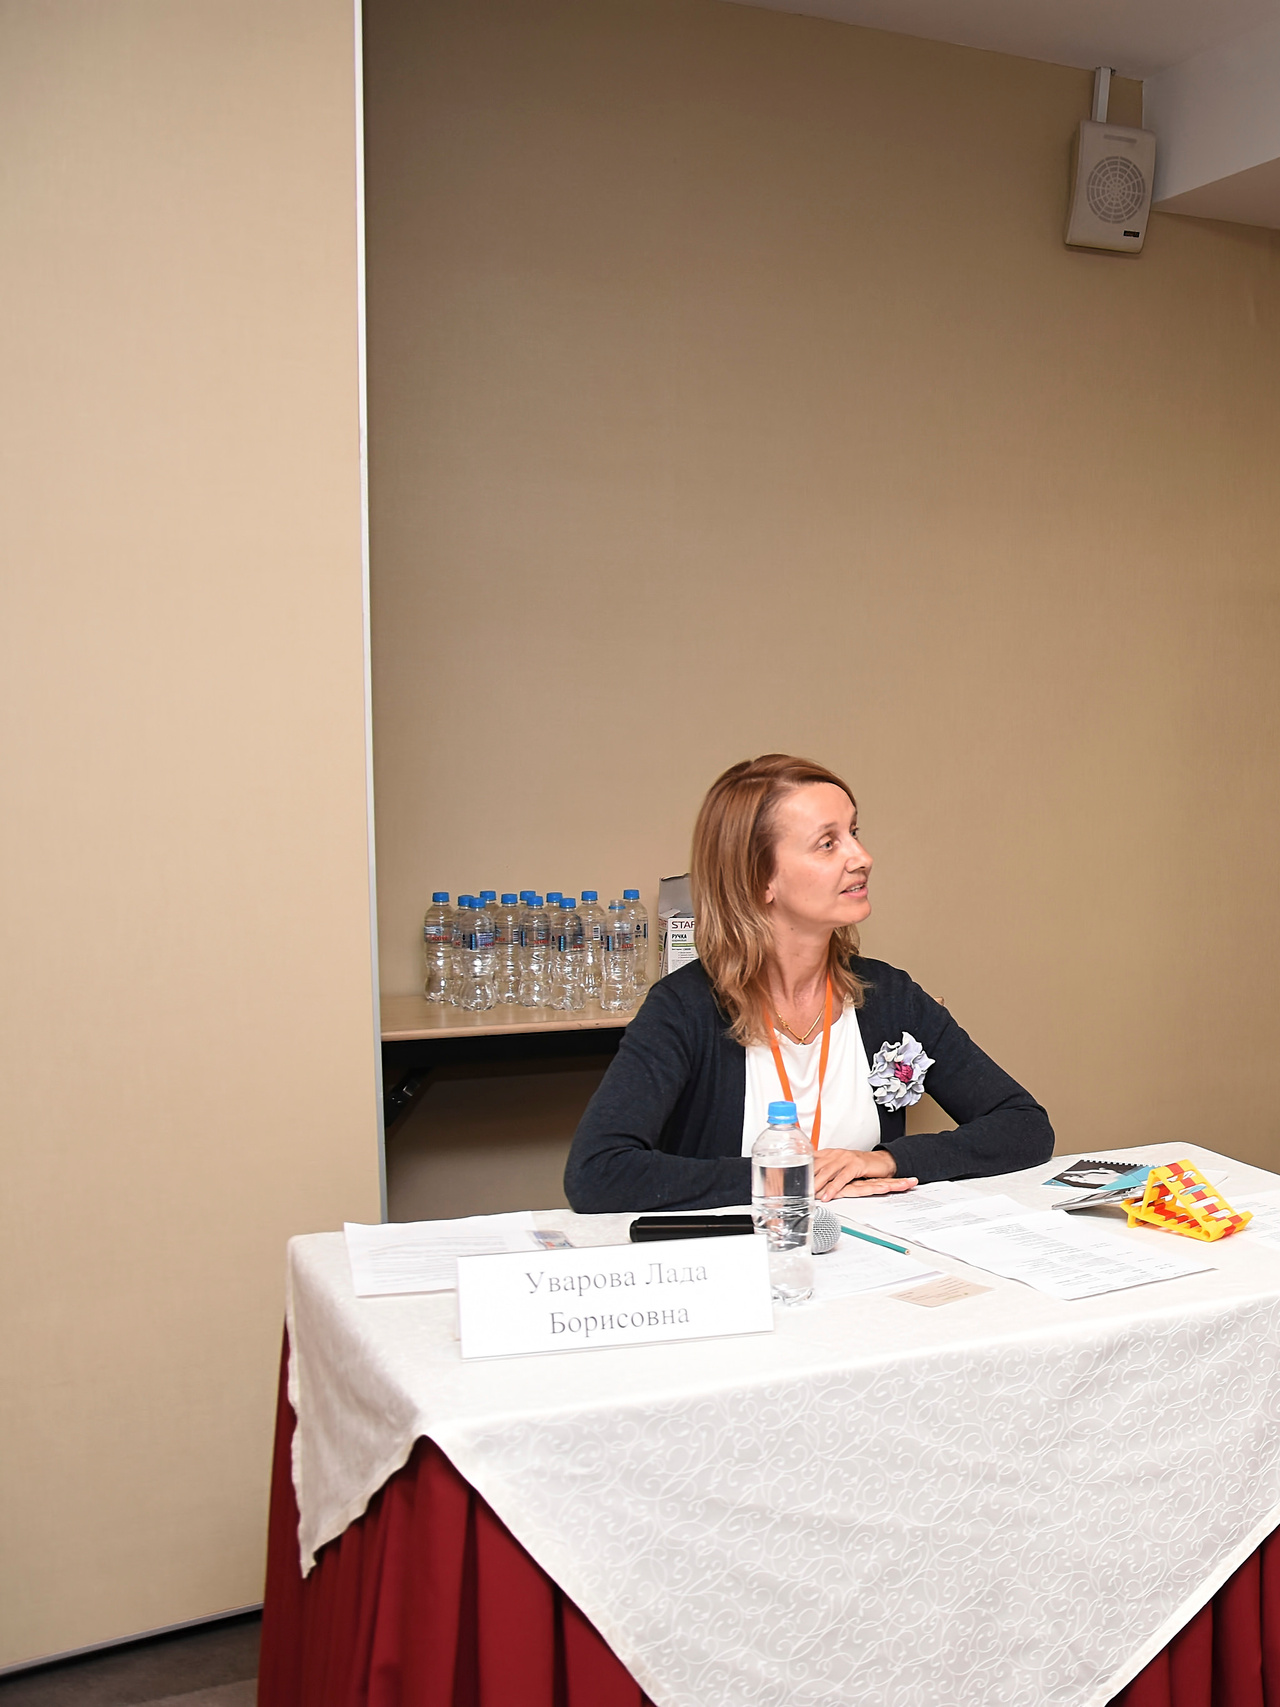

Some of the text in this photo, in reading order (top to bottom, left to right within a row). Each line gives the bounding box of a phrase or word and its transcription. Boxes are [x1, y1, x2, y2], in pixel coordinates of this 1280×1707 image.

[671, 920, 696, 929] STAF
[524, 1262, 709, 1297] Уварова Лада
[548, 1307, 691, 1337] Борисовна
